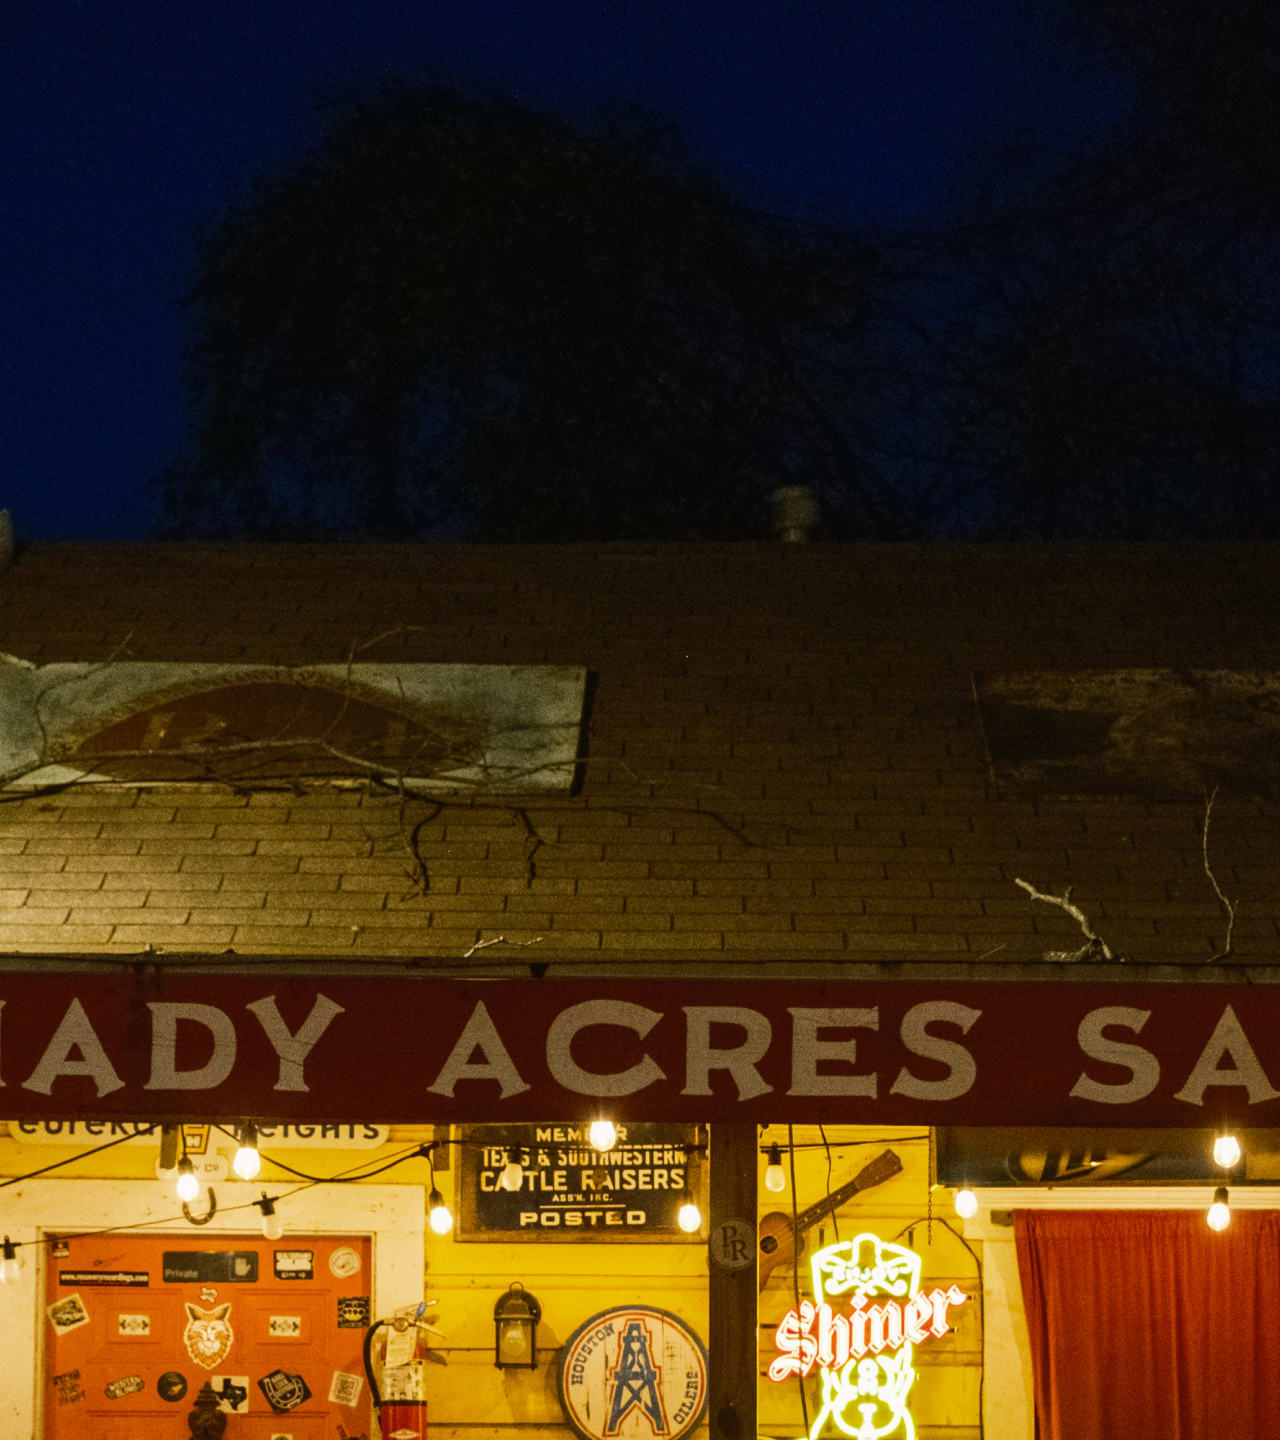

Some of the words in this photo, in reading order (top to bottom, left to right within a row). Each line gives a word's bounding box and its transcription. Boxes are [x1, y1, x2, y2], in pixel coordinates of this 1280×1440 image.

[426, 997, 984, 1103] ACRES
[535, 1126, 629, 1143] MEMR
[479, 1168, 568, 1193] CATLE
[581, 1168, 686, 1191] RAISERS
[519, 1210, 647, 1227] POSTED
[165, 1268, 199, 1280] Private
[768, 1284, 968, 1382] Shiner
[570, 1322, 616, 1386] HOUSTON
[672, 1370, 700, 1426] OILERS
